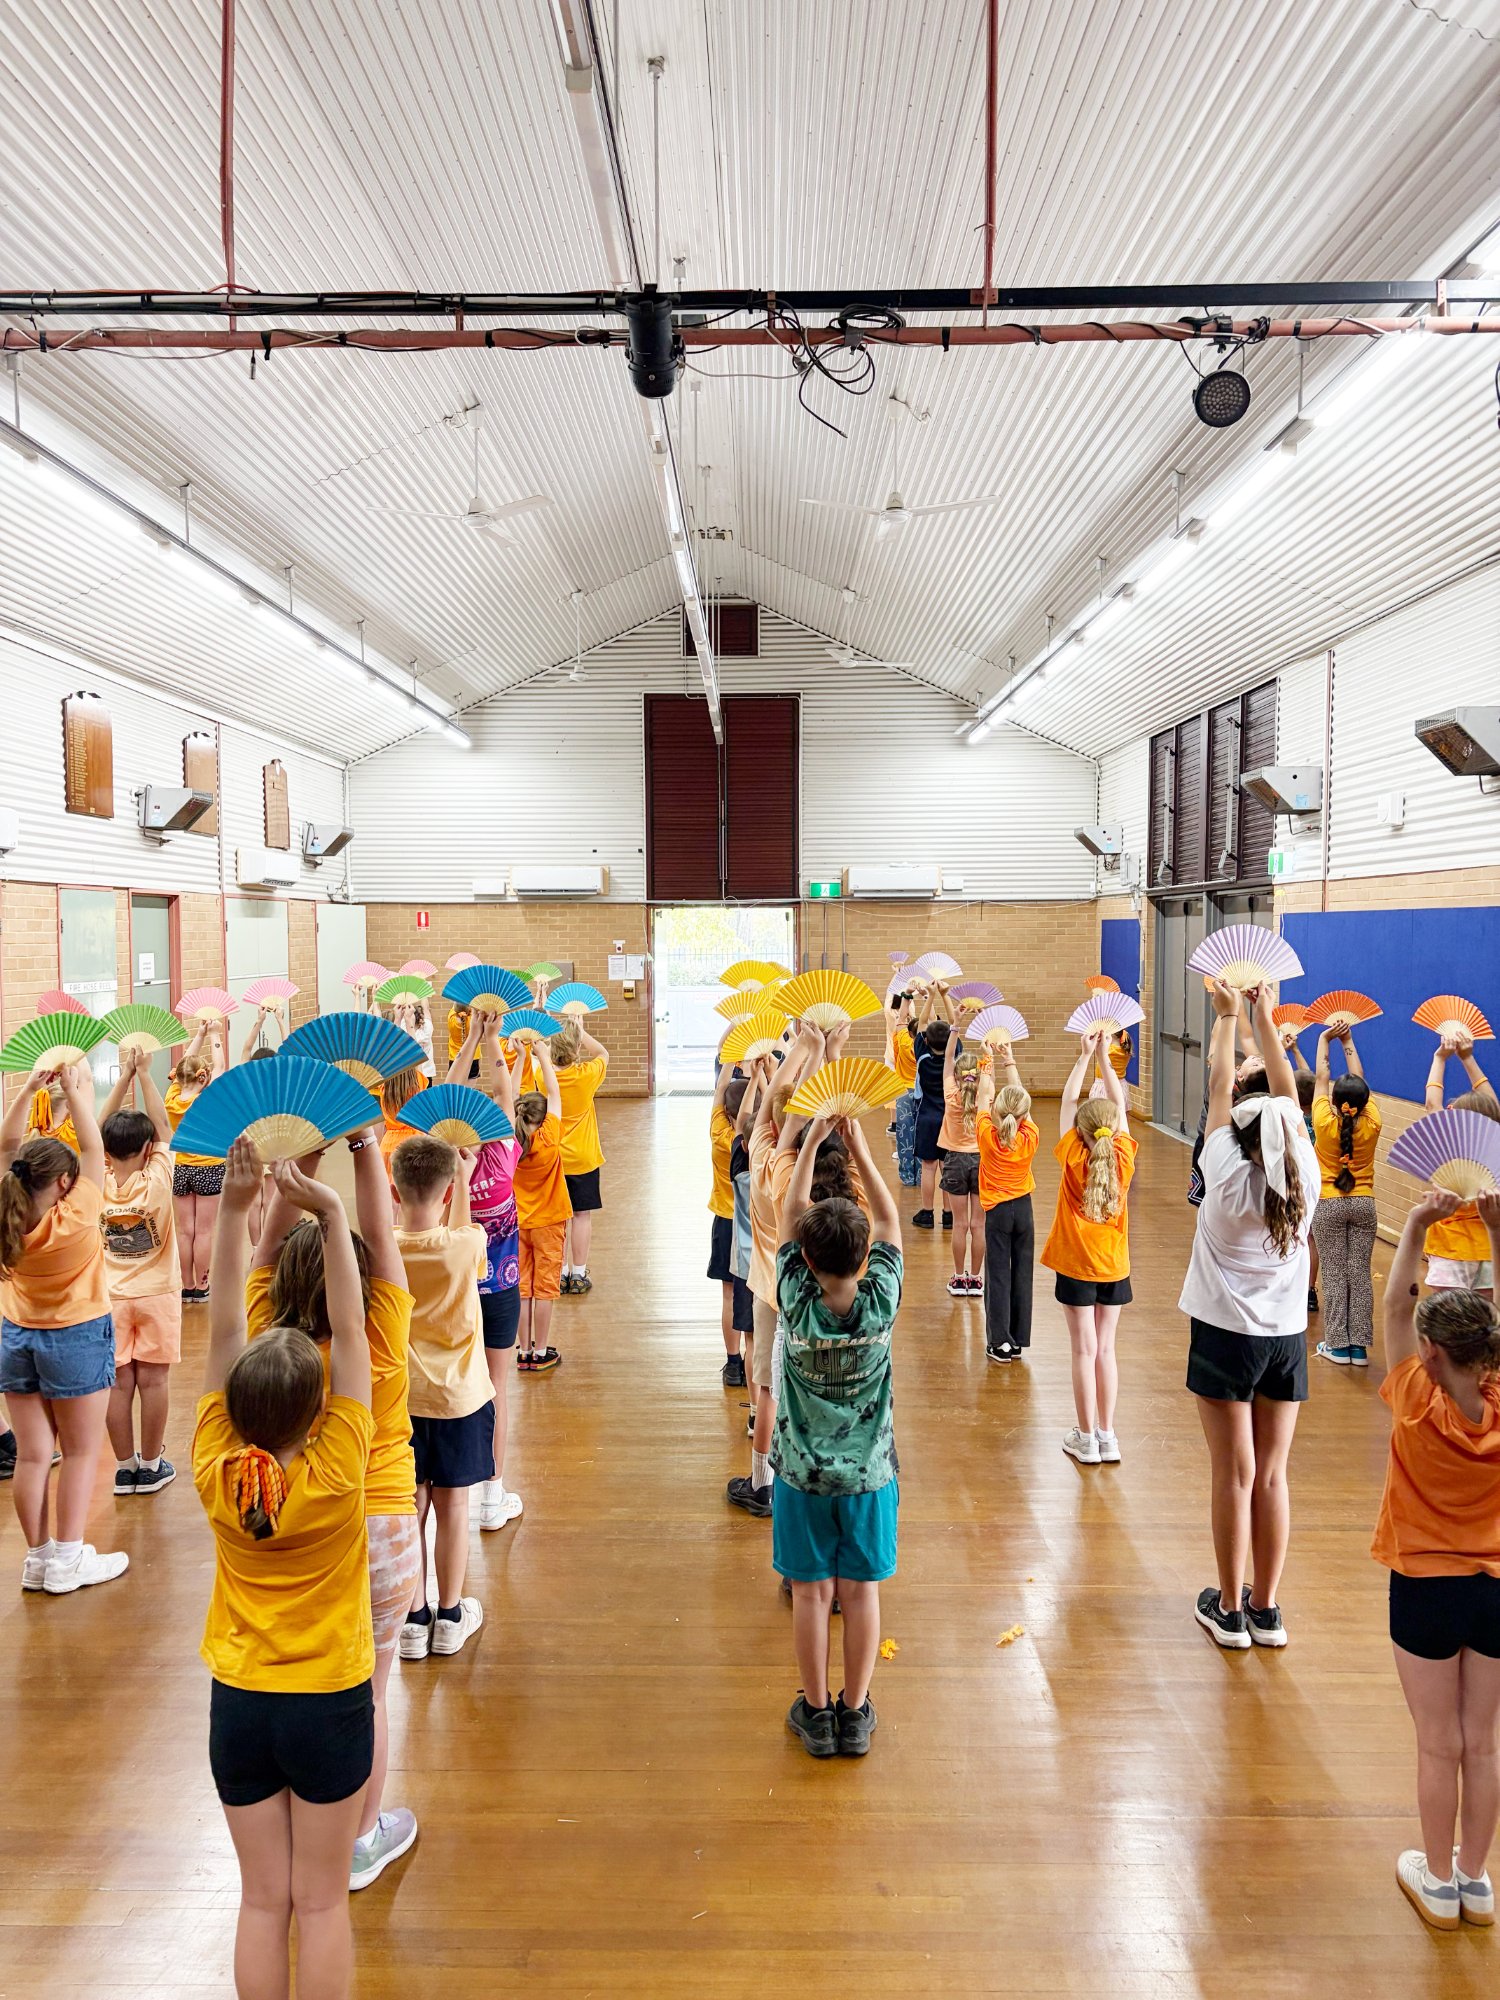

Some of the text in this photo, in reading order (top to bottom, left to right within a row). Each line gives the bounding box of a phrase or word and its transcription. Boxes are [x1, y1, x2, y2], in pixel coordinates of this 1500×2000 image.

[69, 983, 81, 992] FIRE
[83, 983, 97, 991] HOSE
[106, 1207, 145, 1216] COMES
[148, 1217, 162, 1246] WAVES
[816, 1339, 833, 1349] IN
